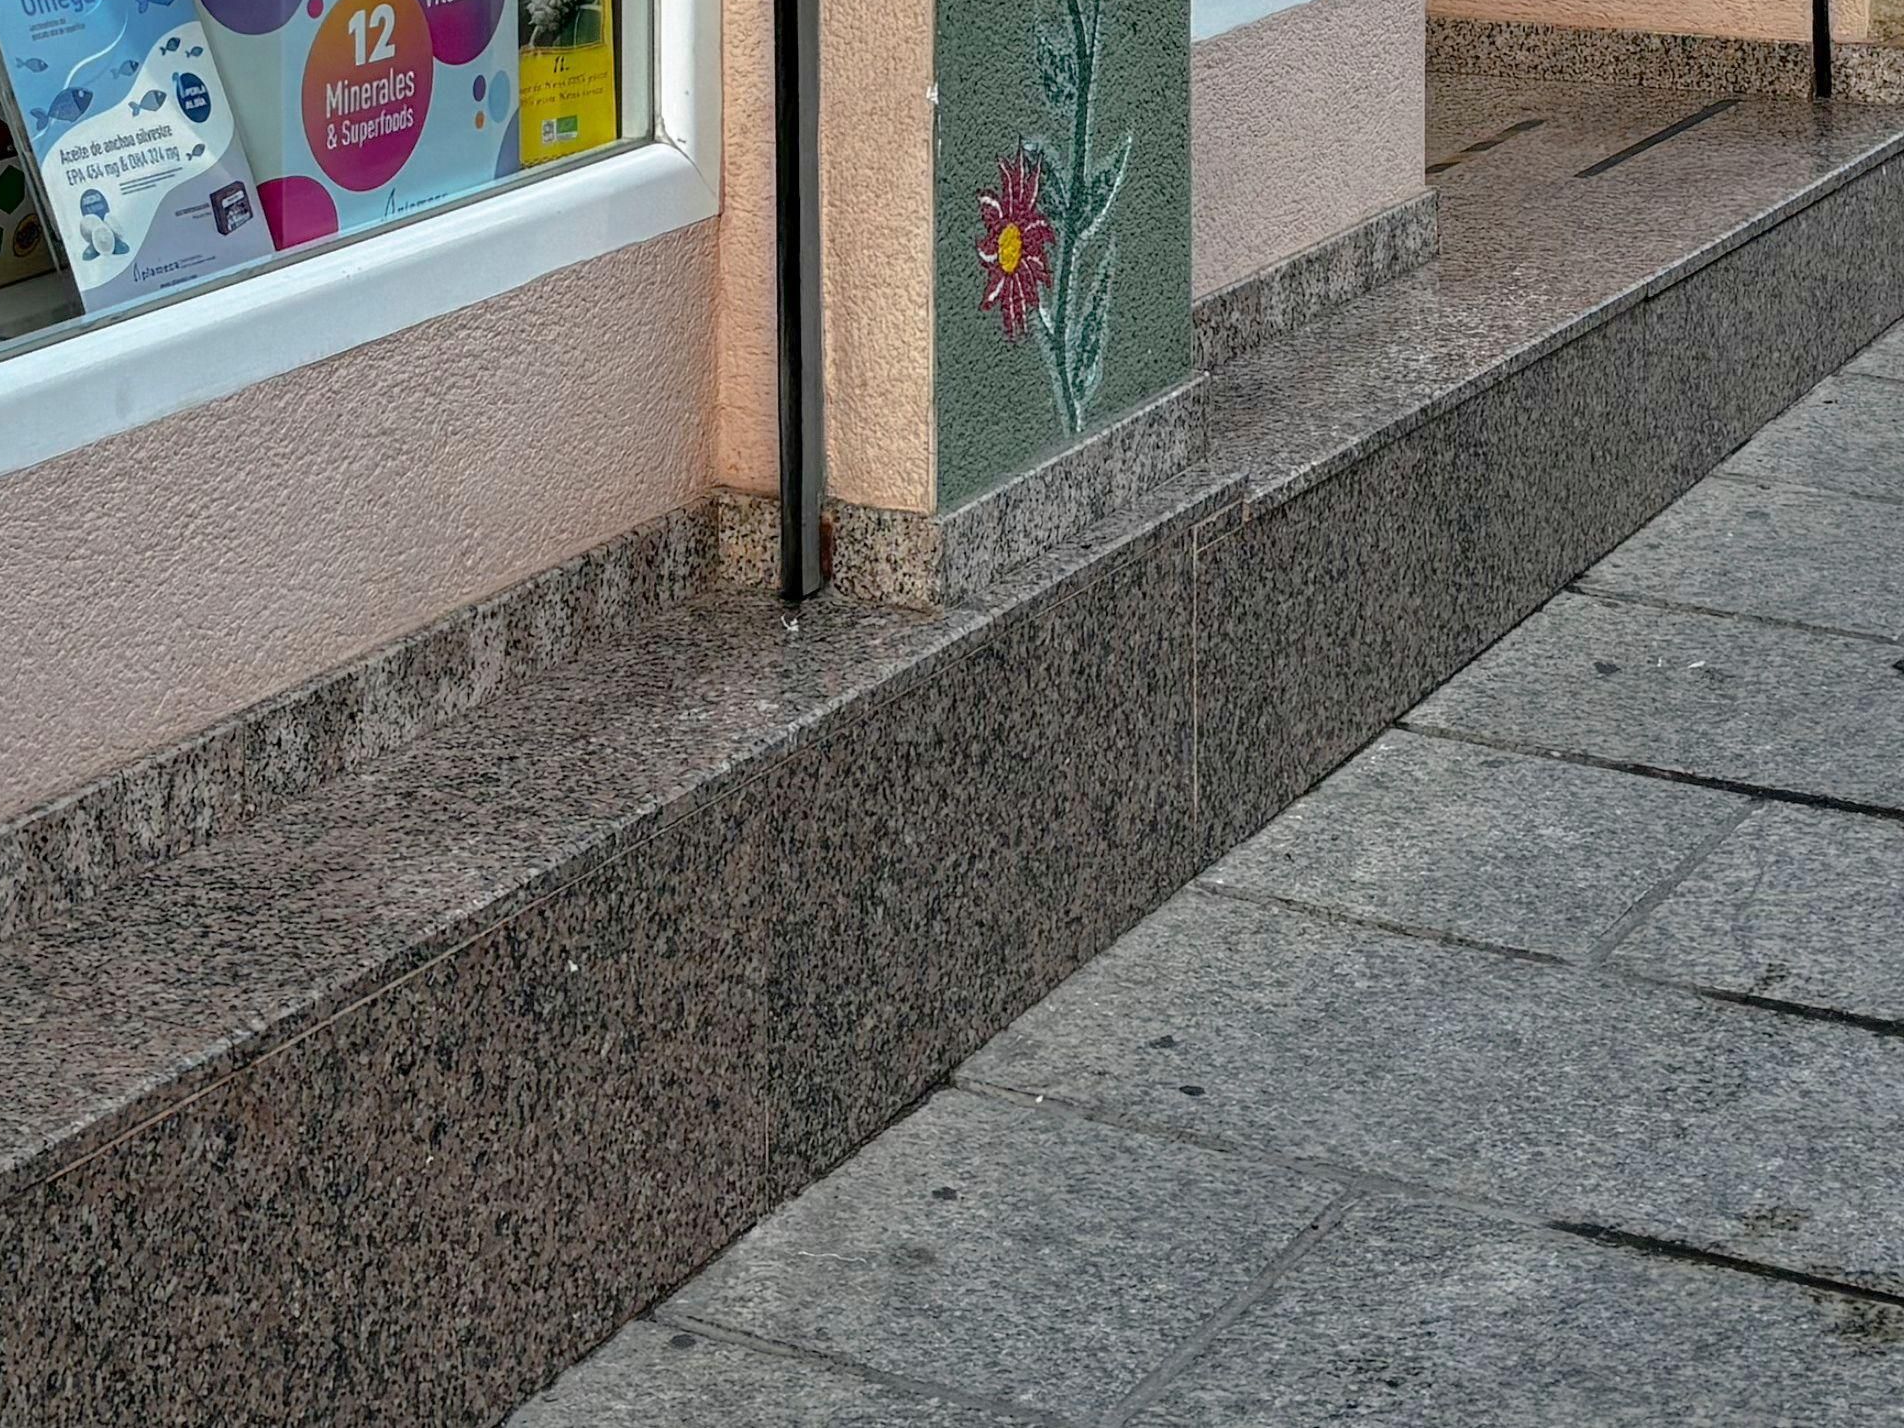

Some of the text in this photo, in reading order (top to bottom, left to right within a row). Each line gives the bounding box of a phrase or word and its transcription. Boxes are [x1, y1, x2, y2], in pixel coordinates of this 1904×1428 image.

[347, 3, 396, 67] 12
[325, 66, 416, 120] Minerales
[59, 144, 89, 166] Aceite
[135, 124, 174, 148] silvestre
[326, 105, 415, 150] & Superfoods
[66, 168, 87, 187] EPA
